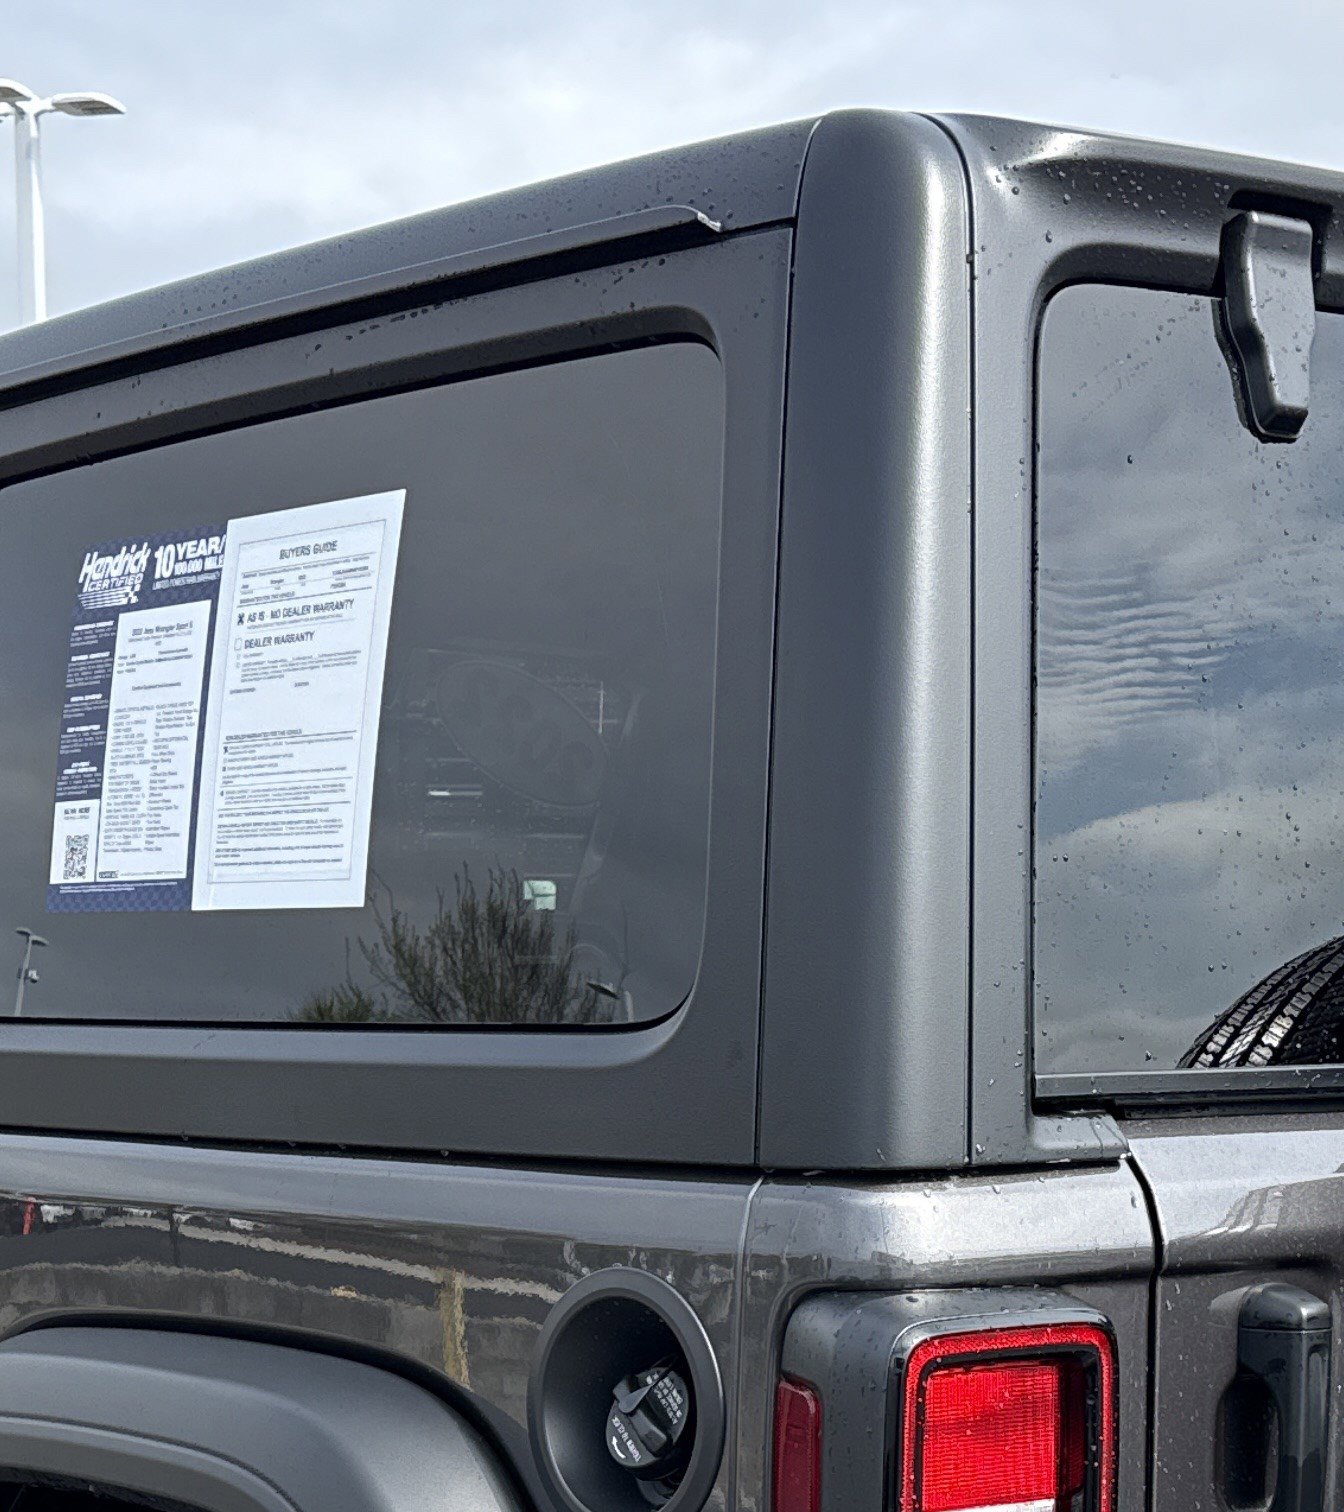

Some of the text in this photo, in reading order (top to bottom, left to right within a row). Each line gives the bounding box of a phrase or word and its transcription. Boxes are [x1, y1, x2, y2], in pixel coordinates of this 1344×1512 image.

[279, 540, 338, 560] BUYERS GUIDE
[78, 542, 152, 592] Hendrick
[154, 544, 176, 580] 10
[88, 572, 144, 592] CERTIFIED
[282, 604, 312, 619] DEALER
[312, 598, 355, 614] WARRANTY
[244, 631, 316, 650] DEALER WARRANTY
